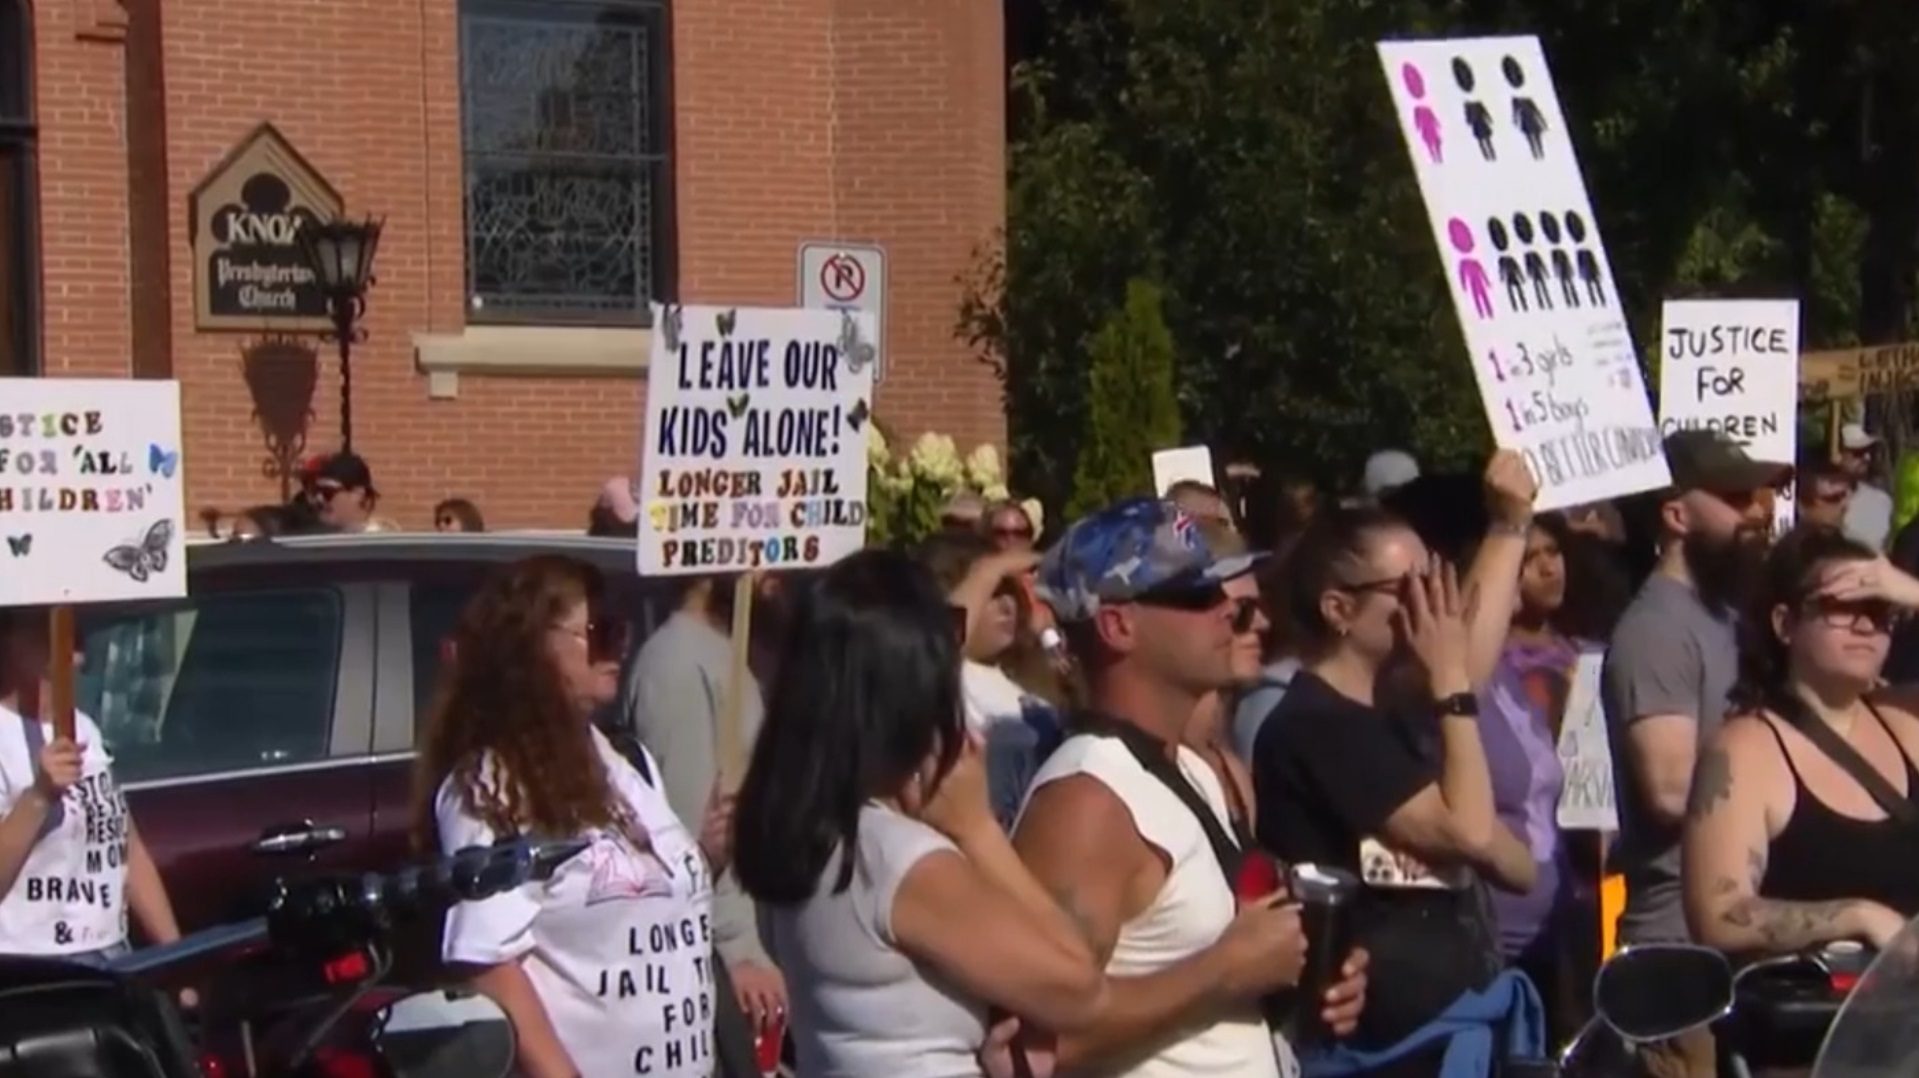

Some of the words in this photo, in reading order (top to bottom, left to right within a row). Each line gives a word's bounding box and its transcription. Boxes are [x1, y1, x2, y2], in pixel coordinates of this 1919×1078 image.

[238, 286, 296, 310] Church
[1668, 325, 1789, 359] JUSTICE
[678, 340, 770, 390] LEAVE
[784, 340, 838, 391] OUR
[1489, 349, 1505, 382] 1
[1517, 341, 1534, 376] 3
[1697, 366, 1745, 402] FOR
[1505, 398, 1522, 432] 1
[1531, 390, 1548, 422] 5
[1547, 391, 1589, 435] boys
[658, 406, 727, 459] KIDS
[743, 405, 840, 457] ALONE!
[658, 468, 761, 498] LONGER
[777, 468, 839, 498] JAIL
[650, 502, 719, 532] TIME
[731, 502, 780, 528] FOR
[790, 498, 865, 527] CHILD
[661, 536, 819, 567] PREDITORS
[27, 877, 111, 909] BRAVE
[54, 920, 73, 945] &
[597, 964, 671, 998] JAIL
[663, 992, 710, 1033] FOR
[634, 1029, 708, 1075] CHIL
